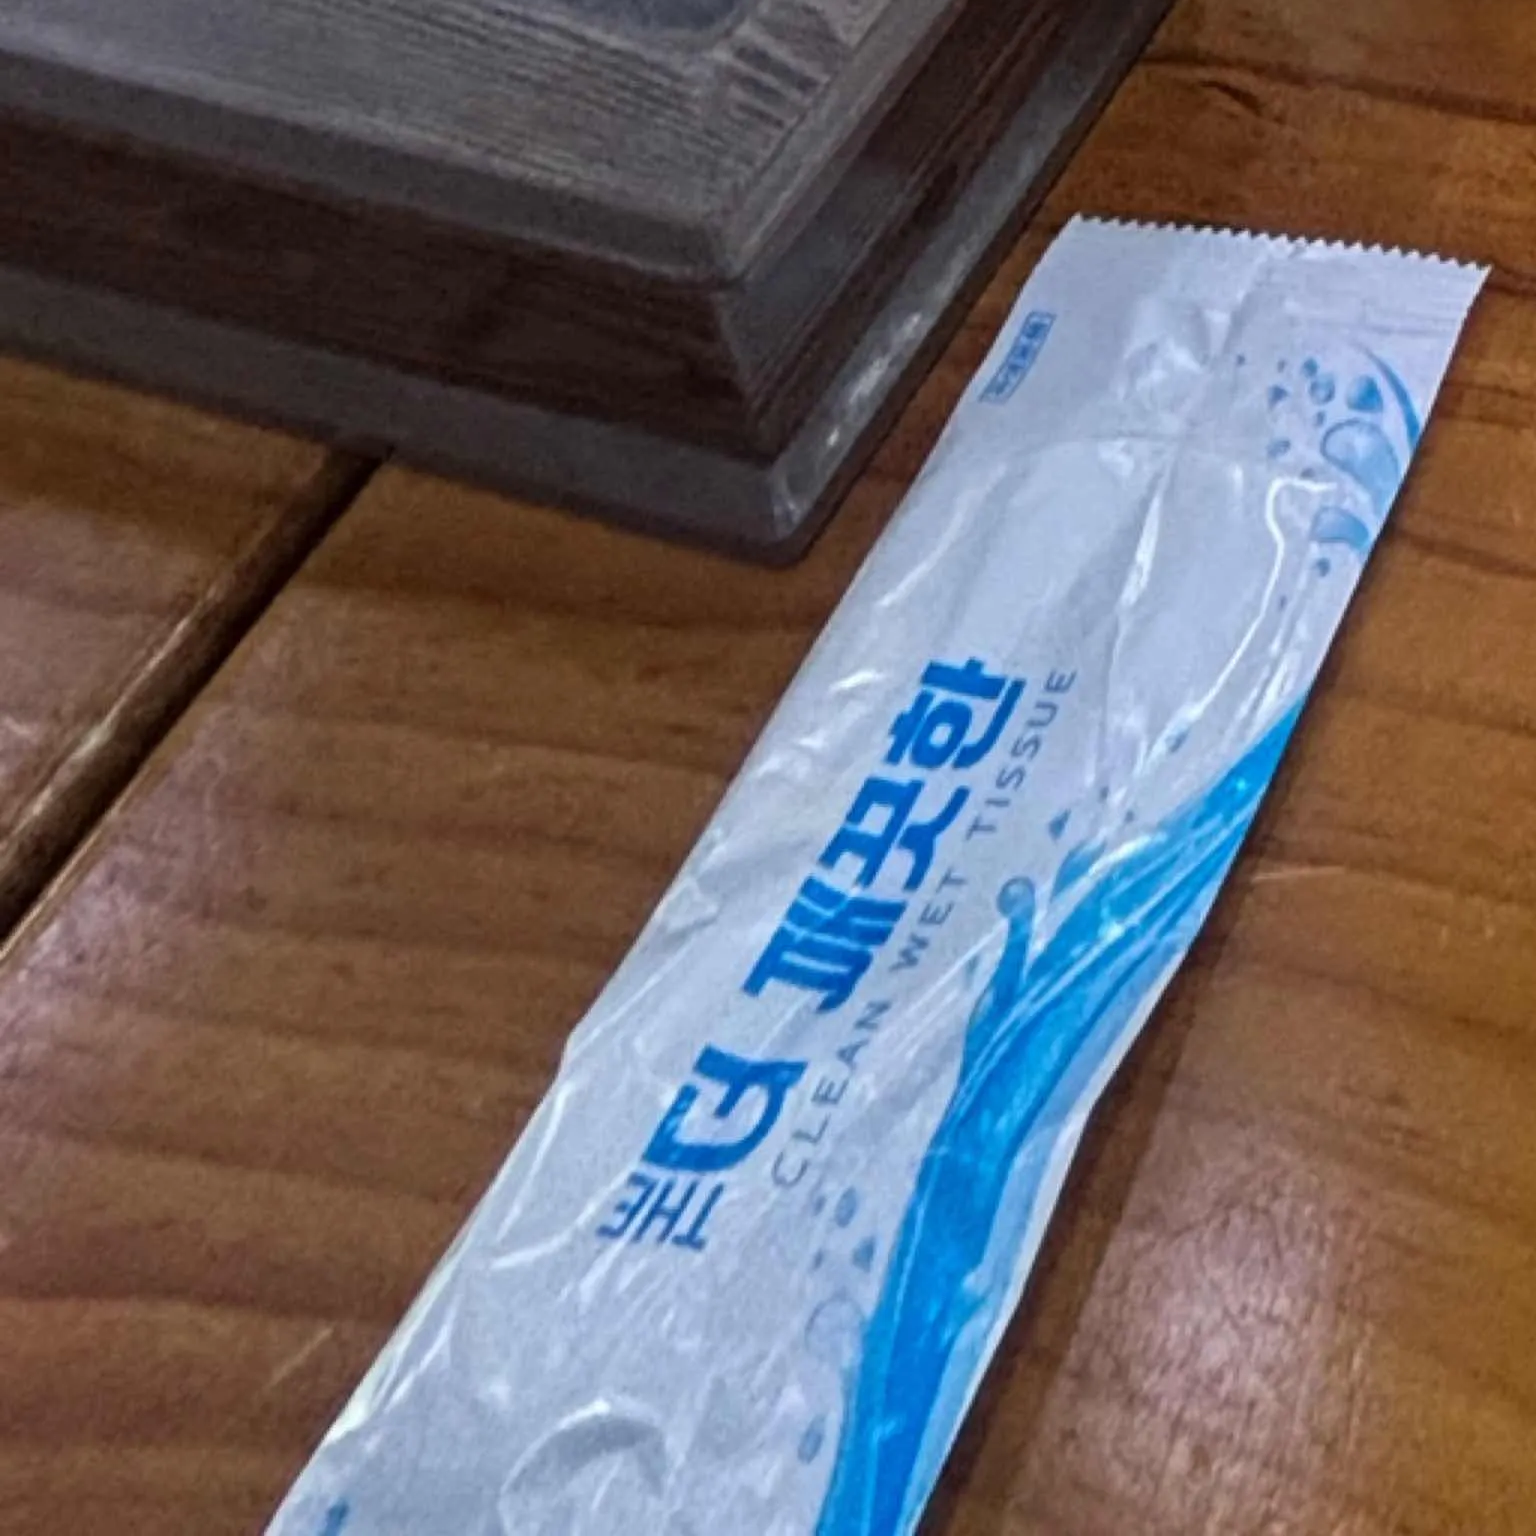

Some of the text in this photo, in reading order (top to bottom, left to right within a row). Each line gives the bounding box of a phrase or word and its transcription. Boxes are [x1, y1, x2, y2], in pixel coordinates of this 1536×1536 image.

[743, 656, 1027, 1014] 깨끗한
[772, 669, 1077, 1188] CLEAN WET TISSUE
[595, 1171, 725, 1253] THE
[641, 1044, 809, 1174] 더
